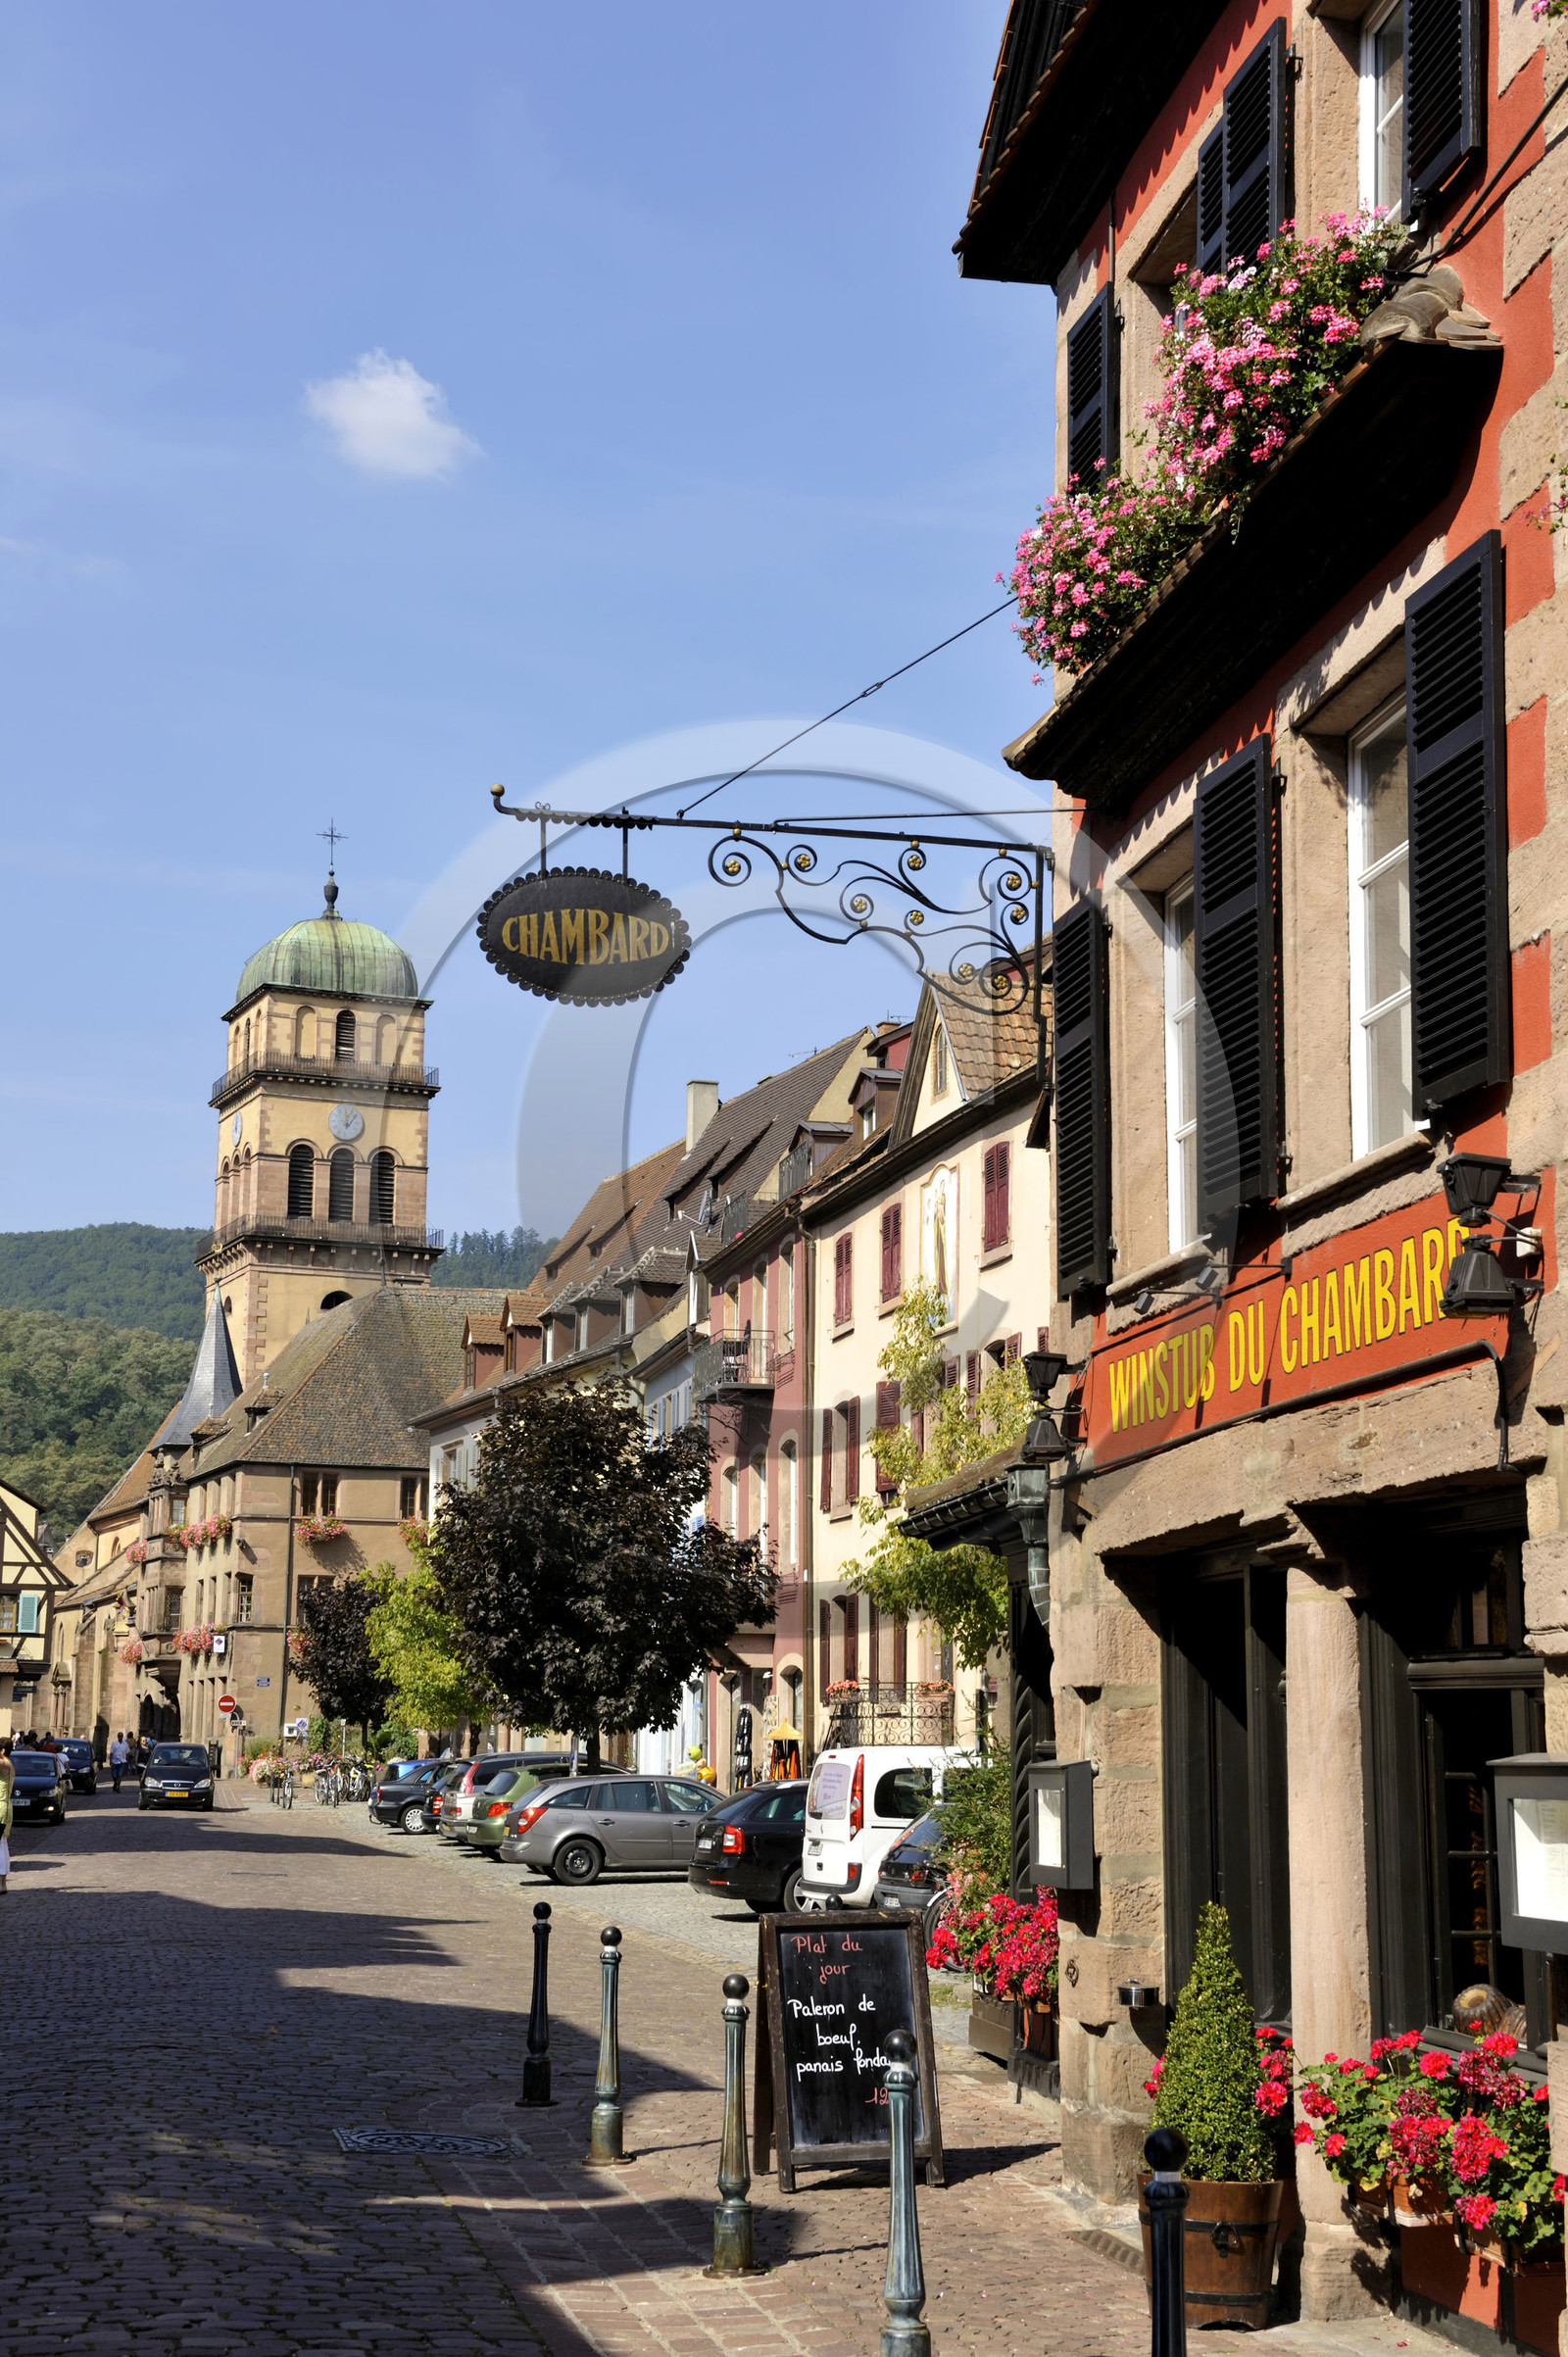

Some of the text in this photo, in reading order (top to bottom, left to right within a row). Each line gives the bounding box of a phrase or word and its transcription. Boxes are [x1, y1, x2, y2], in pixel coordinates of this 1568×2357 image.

[502, 908, 669, 965] CHAMBARD
[1108, 1323, 1215, 1434] WINSTUB
[1229, 1299, 1265, 1394] DU
[790, 1933, 863, 1953] Plat du
[819, 1958, 851, 1985] jour
[787, 1992, 876, 2019] Paleron de
[796, 2046, 892, 2083] panais fonda
[864, 2087, 890, 2106] 12
